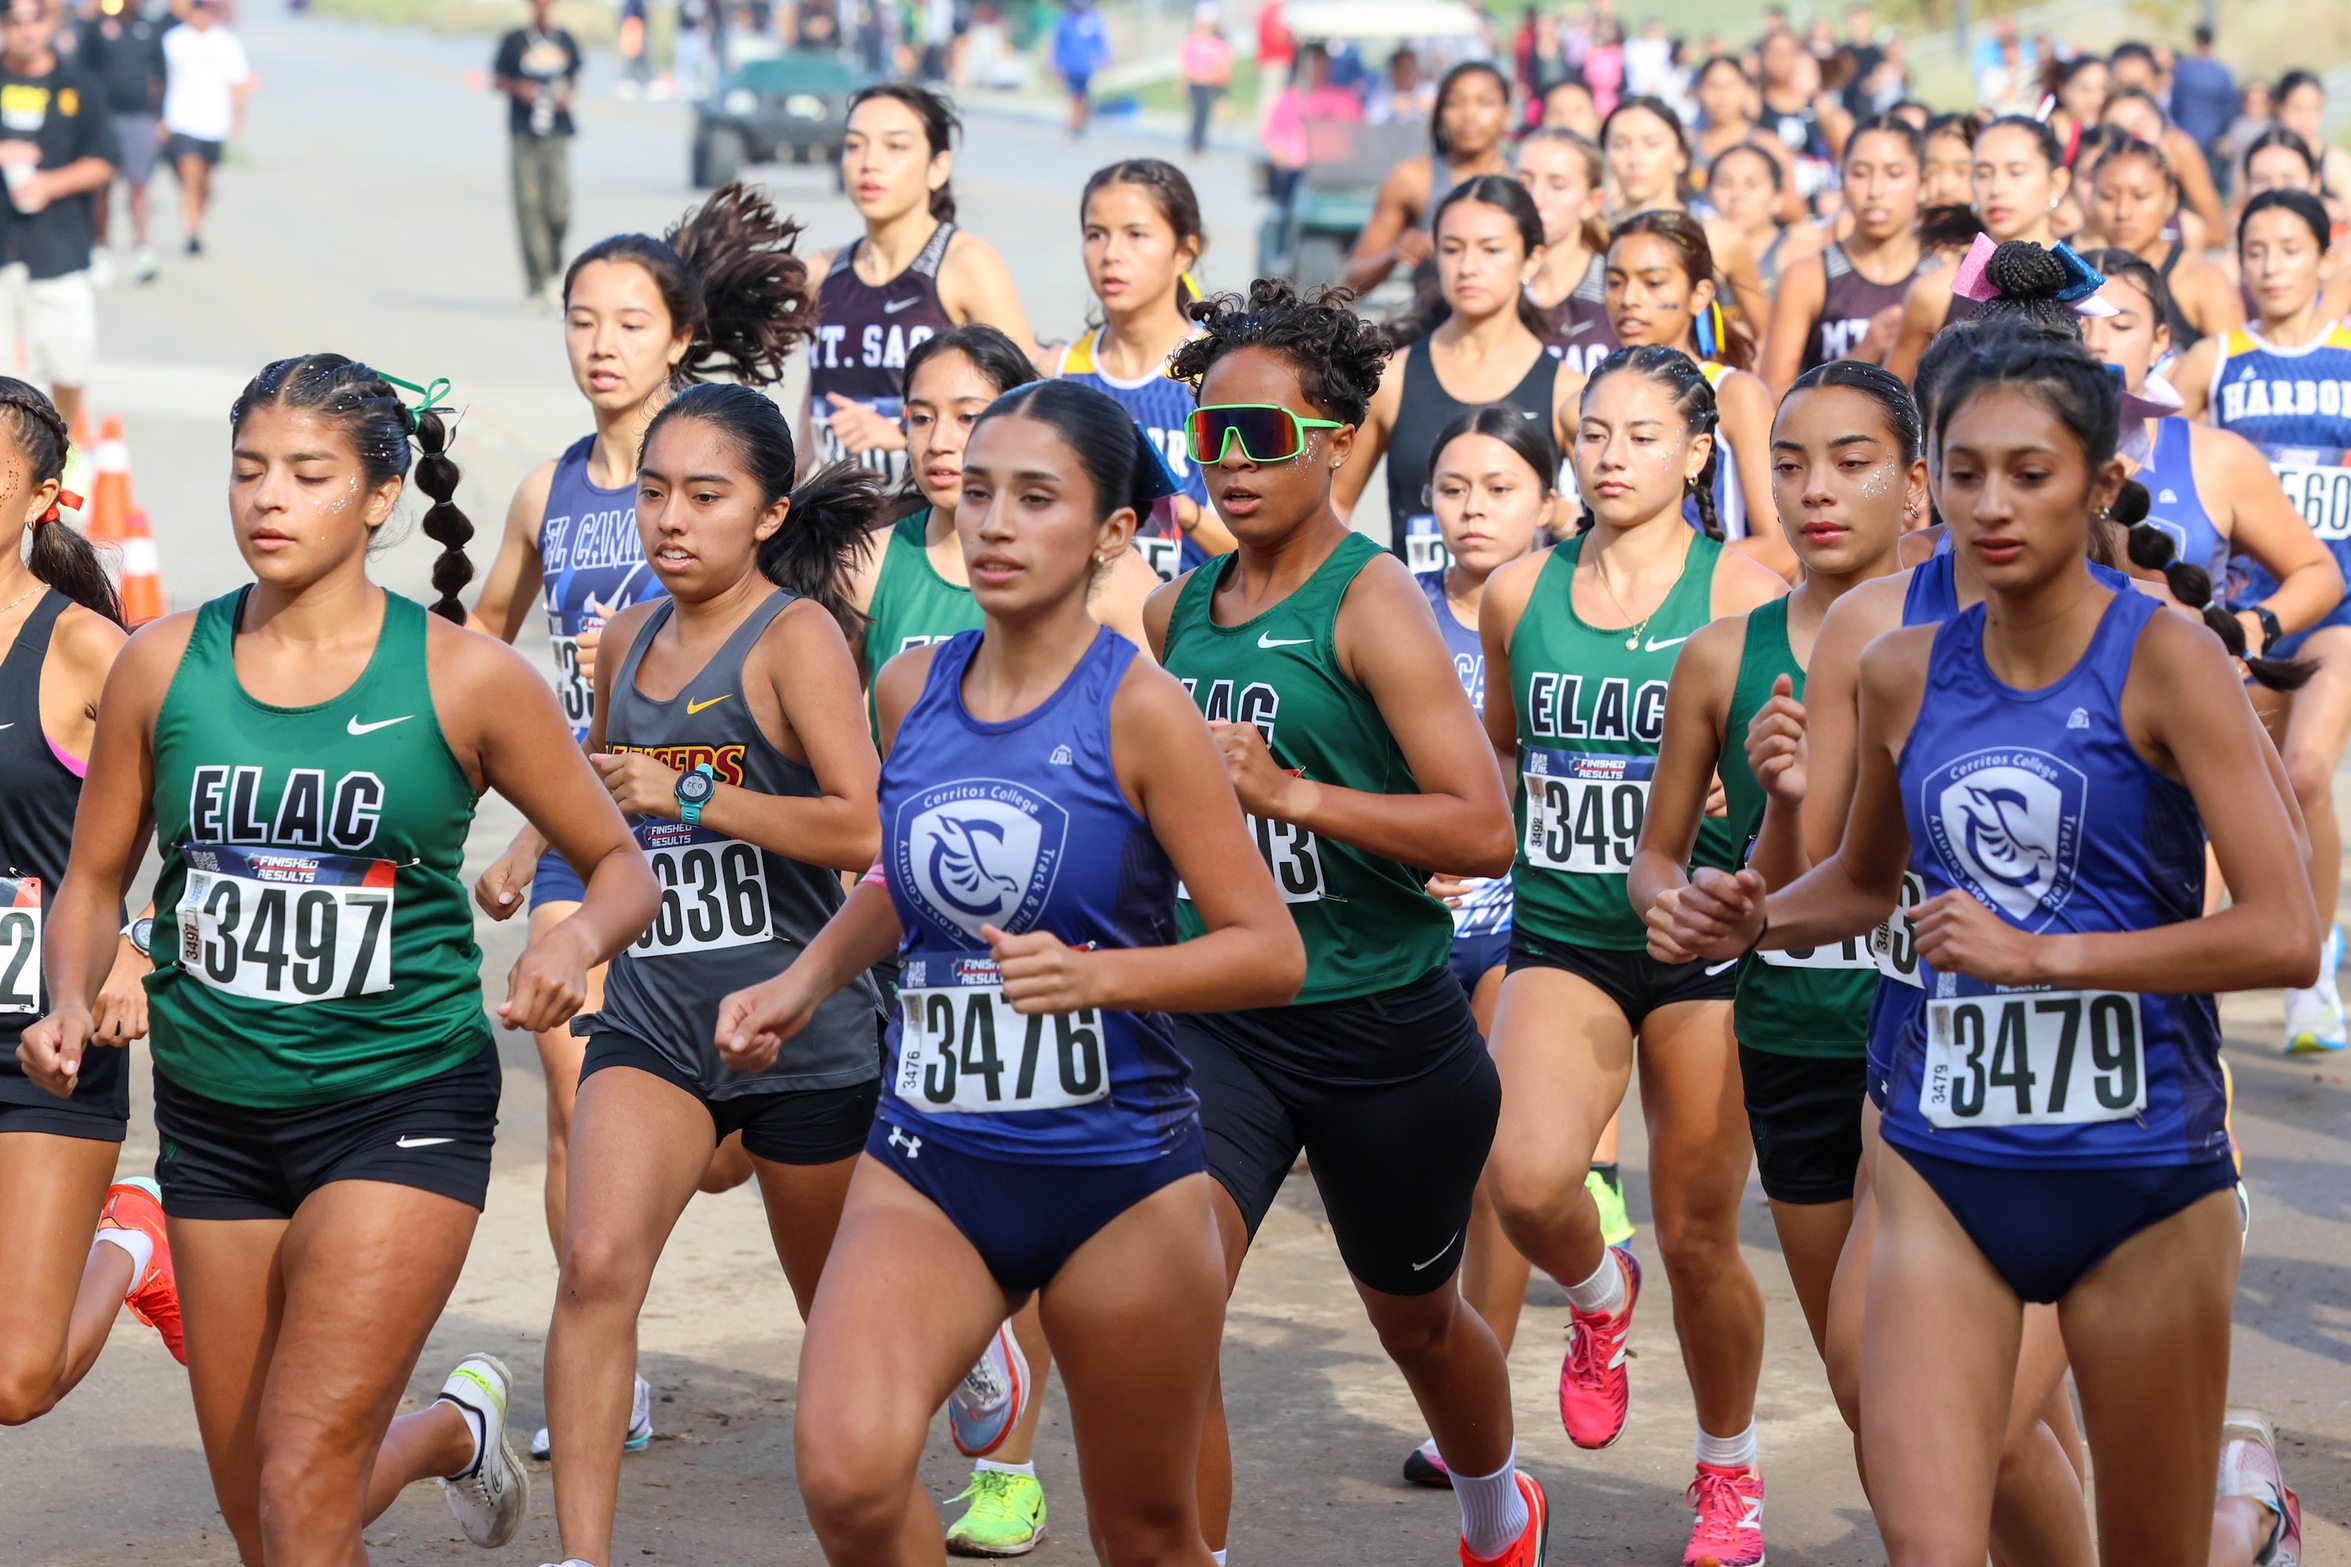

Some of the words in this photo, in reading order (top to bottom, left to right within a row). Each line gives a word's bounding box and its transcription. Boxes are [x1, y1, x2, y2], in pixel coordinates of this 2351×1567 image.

[1529, 671, 1669, 743] ELAC
[1578, 769, 1624, 780] RESULTS
[1580, 758, 1627, 769] FINISHED
[1950, 754, 2010, 781] Cerritos
[2012, 753, 2059, 782] College
[189, 765, 385, 850] ELAC
[923, 786, 987, 809] Cerritos
[990, 785, 1039, 815] College
[651, 834, 692, 848] RESULTS
[1531, 817, 1544, 848] 3492
[1929, 813, 1966, 880] Country
[257, 869, 316, 883] RESULTS
[259, 855, 320, 869] FINISHED
[899, 839, 923, 904] Country
[1031, 848, 1056, 892] Track
[636, 843, 767, 948] 636
[1026, 895, 1039, 907] &
[203, 880, 388, 997] 3497
[926, 905, 964, 939] Cross
[1876, 919, 1889, 951] 348
[185, 923, 199, 960] 3497
[961, 972, 1004, 985] RESUL
[924, 993, 1101, 1104] 3476
[1951, 993, 2138, 1117] 3479
[902, 1051, 921, 1089] 3476
[1931, 1064, 1948, 1105] 3479
